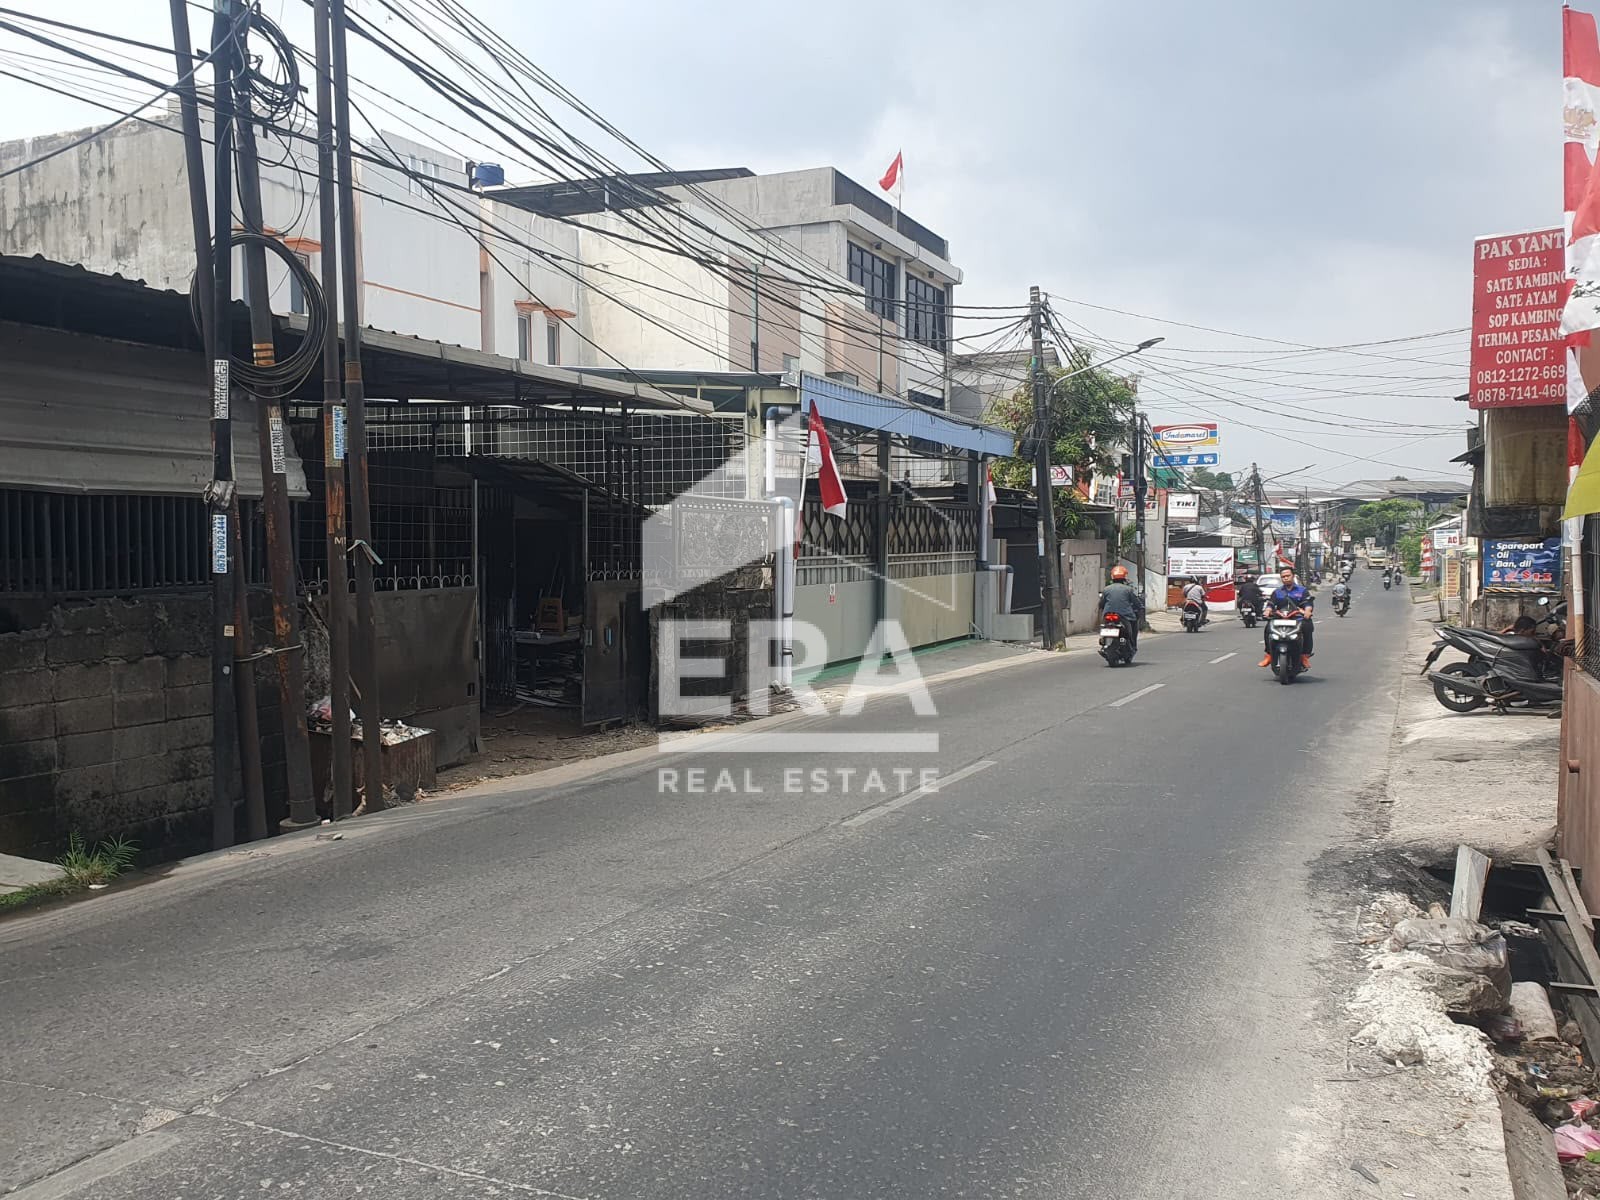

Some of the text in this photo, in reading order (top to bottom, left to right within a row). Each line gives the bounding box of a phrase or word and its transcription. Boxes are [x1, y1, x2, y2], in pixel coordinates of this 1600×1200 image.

[1480, 240, 1514, 259] PAK
[1508, 256, 1541, 271] SEDIA
[1486, 277, 1514, 293] SATE
[1496, 290, 1557, 309] SATE AYAM
[1489, 308, 1563, 328] SOP KAMBING
[1478, 332, 1519, 347] TERIMA
[1496, 347, 1548, 364] CONTACT
[1477, 364, 1567, 384] 0812-1272-669
[1477, 383, 1567, 403] 0878-7141-460
[1496, 542, 1544, 551] Sparepart
[1496, 560, 1517, 568] Ban,
